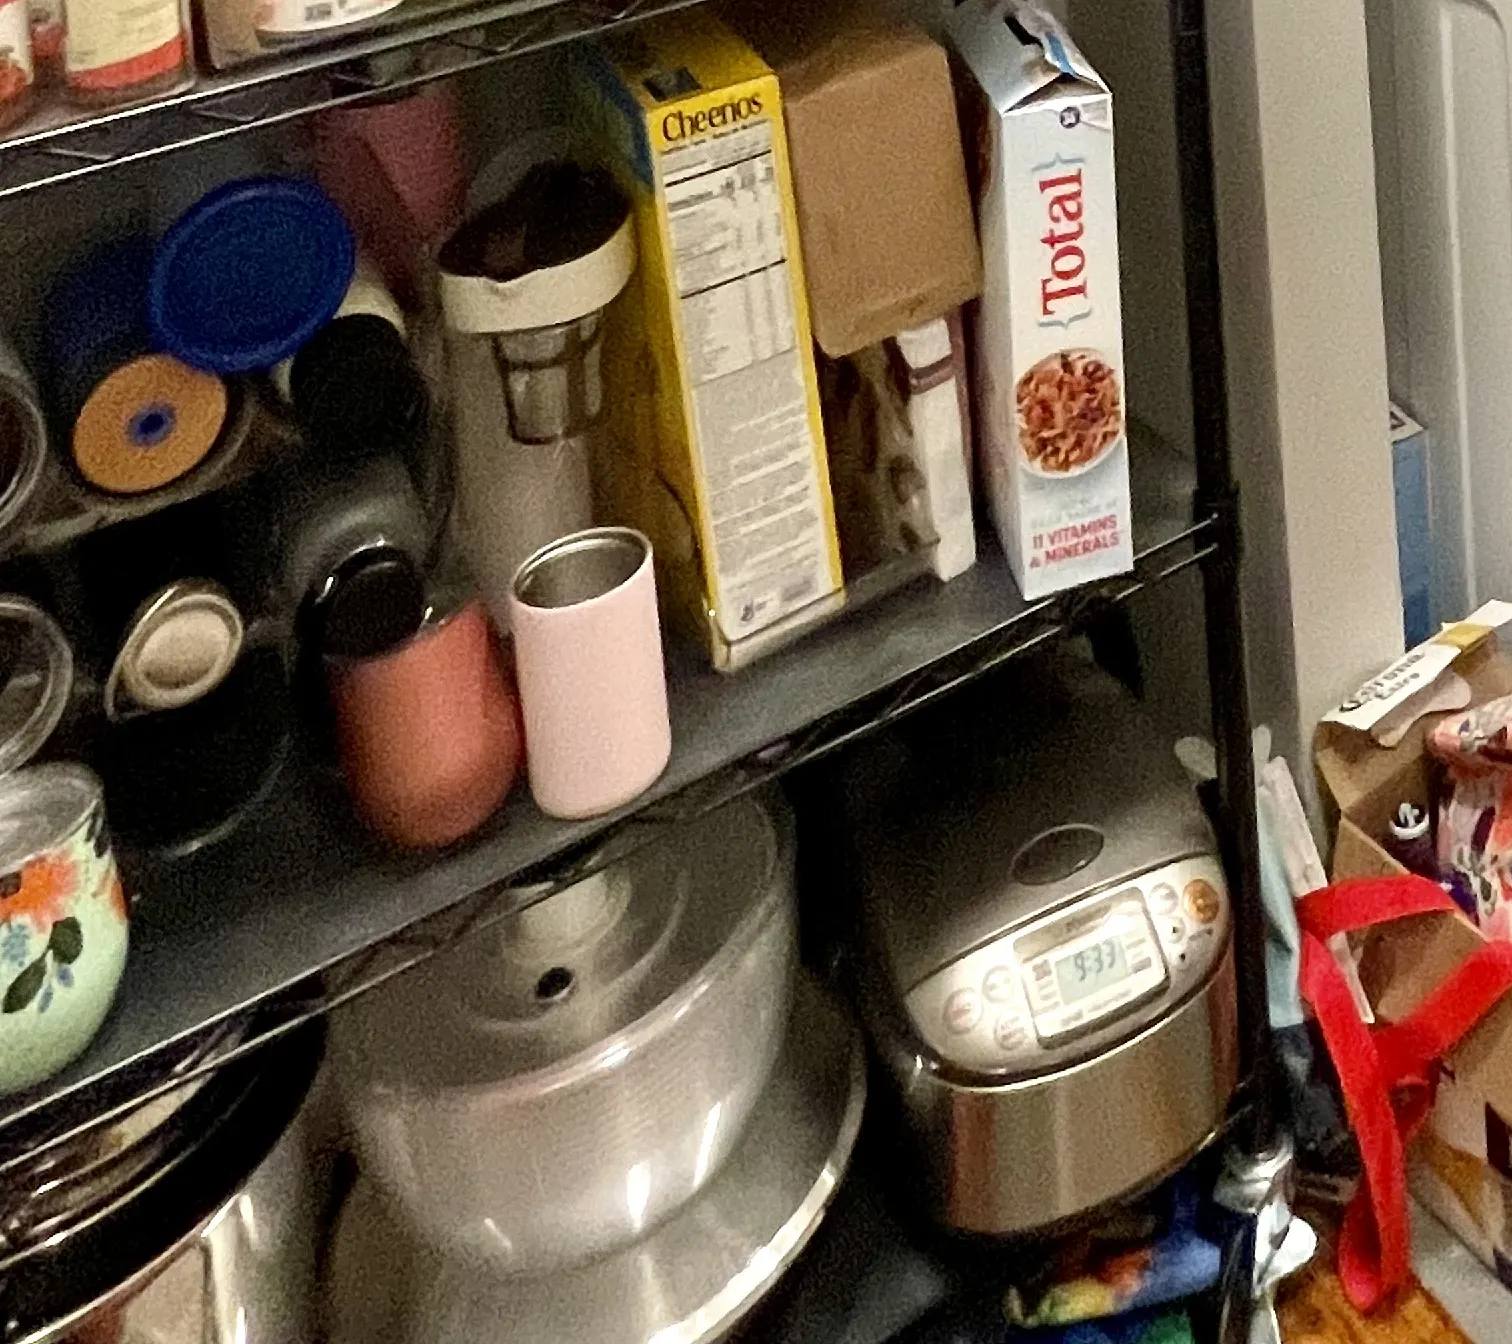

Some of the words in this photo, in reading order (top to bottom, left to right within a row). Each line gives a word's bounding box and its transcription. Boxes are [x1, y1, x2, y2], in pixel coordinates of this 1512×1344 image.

[1039, 167, 1088, 316] Total
[1044, 530, 1120, 563] MINERALS
[1047, 514, 1118, 546] VITAMINS
